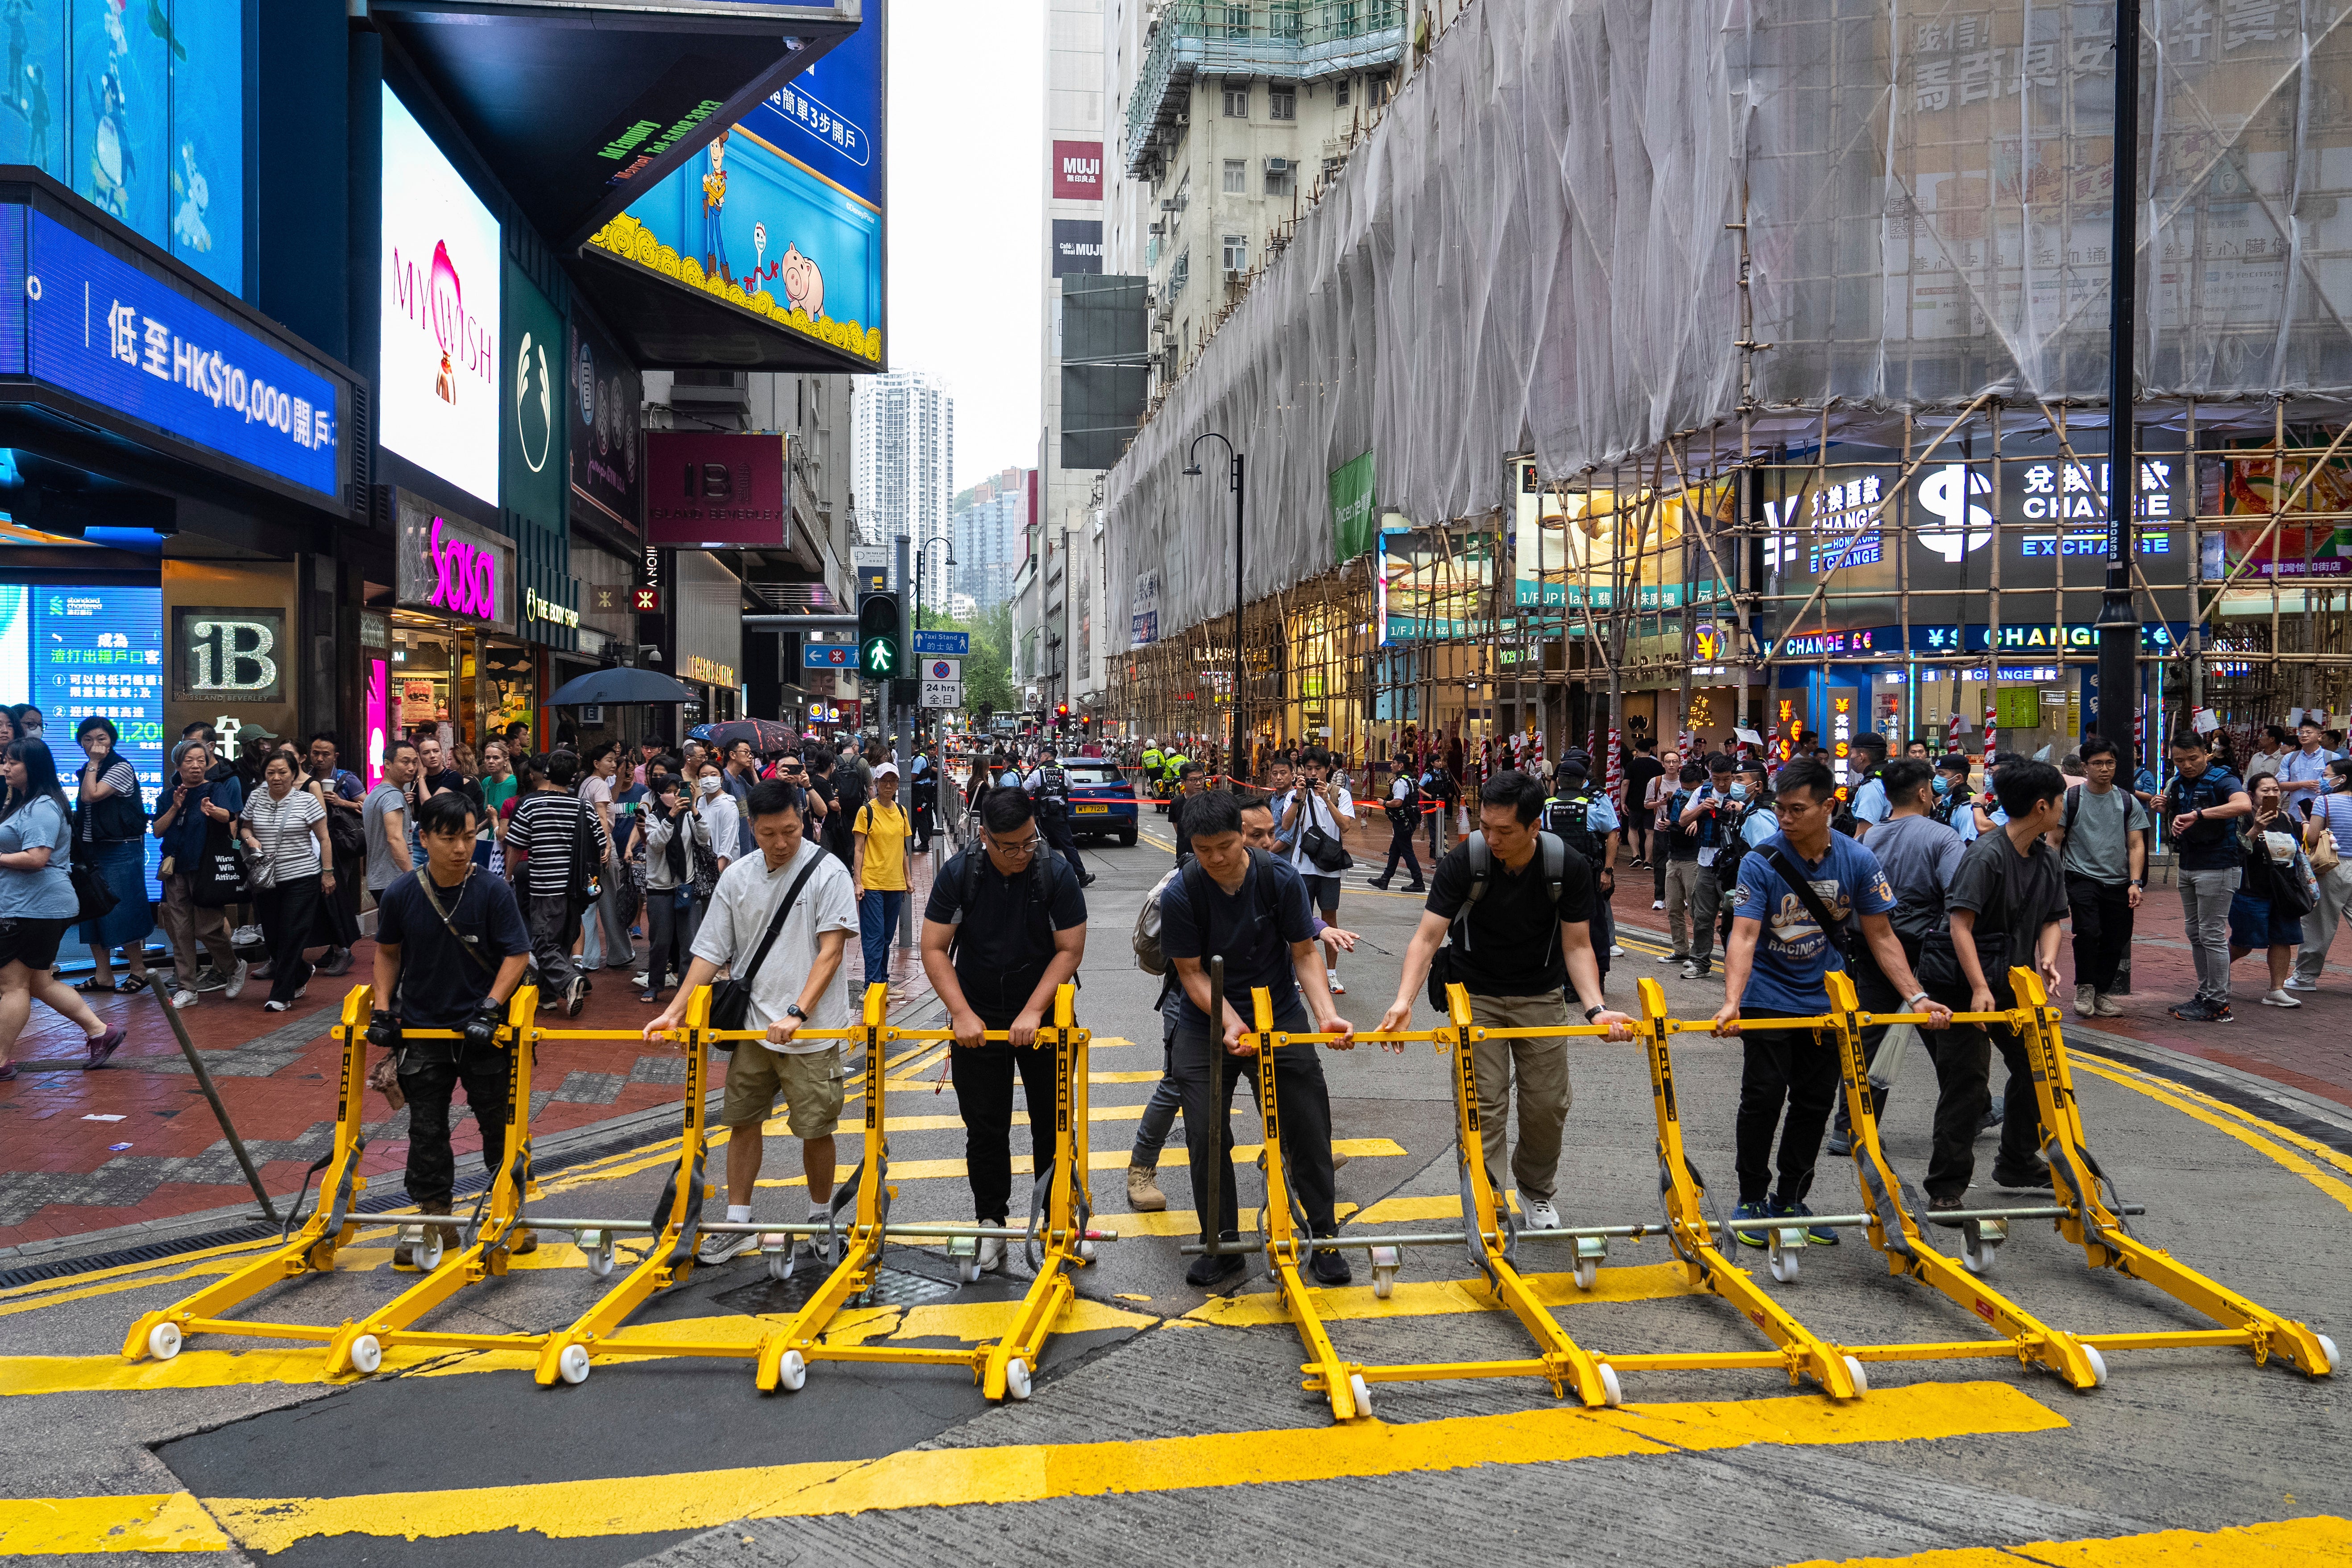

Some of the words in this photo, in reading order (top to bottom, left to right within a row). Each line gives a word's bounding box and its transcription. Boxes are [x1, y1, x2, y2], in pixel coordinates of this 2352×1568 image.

[597, 141, 624, 160] Ad
[613, 120, 662, 154] Enquiry
[1063, 158, 1099, 174] MUJI
[1066, 174, 1096, 183] 無印良品
[1076, 243, 1103, 256] MUJI
[394, 246, 431, 330] MY
[439, 288, 492, 384] WISH
[2022, 461, 2171, 494] 兌換款
[650, 508, 703, 520] ISLAND
[709, 508, 780, 520] BEVERLEY
[2022, 494, 2170, 519] CHAE
[2110, 521, 2119, 560] 50239
[1543, 592, 1559, 604] JP
[537, 597, 548, 619] THE
[550, 602, 564, 624] BODY
[565, 608, 579, 628] SHOP
[927, 642, 954, 651] 的士站
[1786, 635, 1845, 655] CHANGE
[926, 684, 938, 692] 24
[929, 694, 952, 705] 全日
[1768, 939, 1815, 955] RACING
